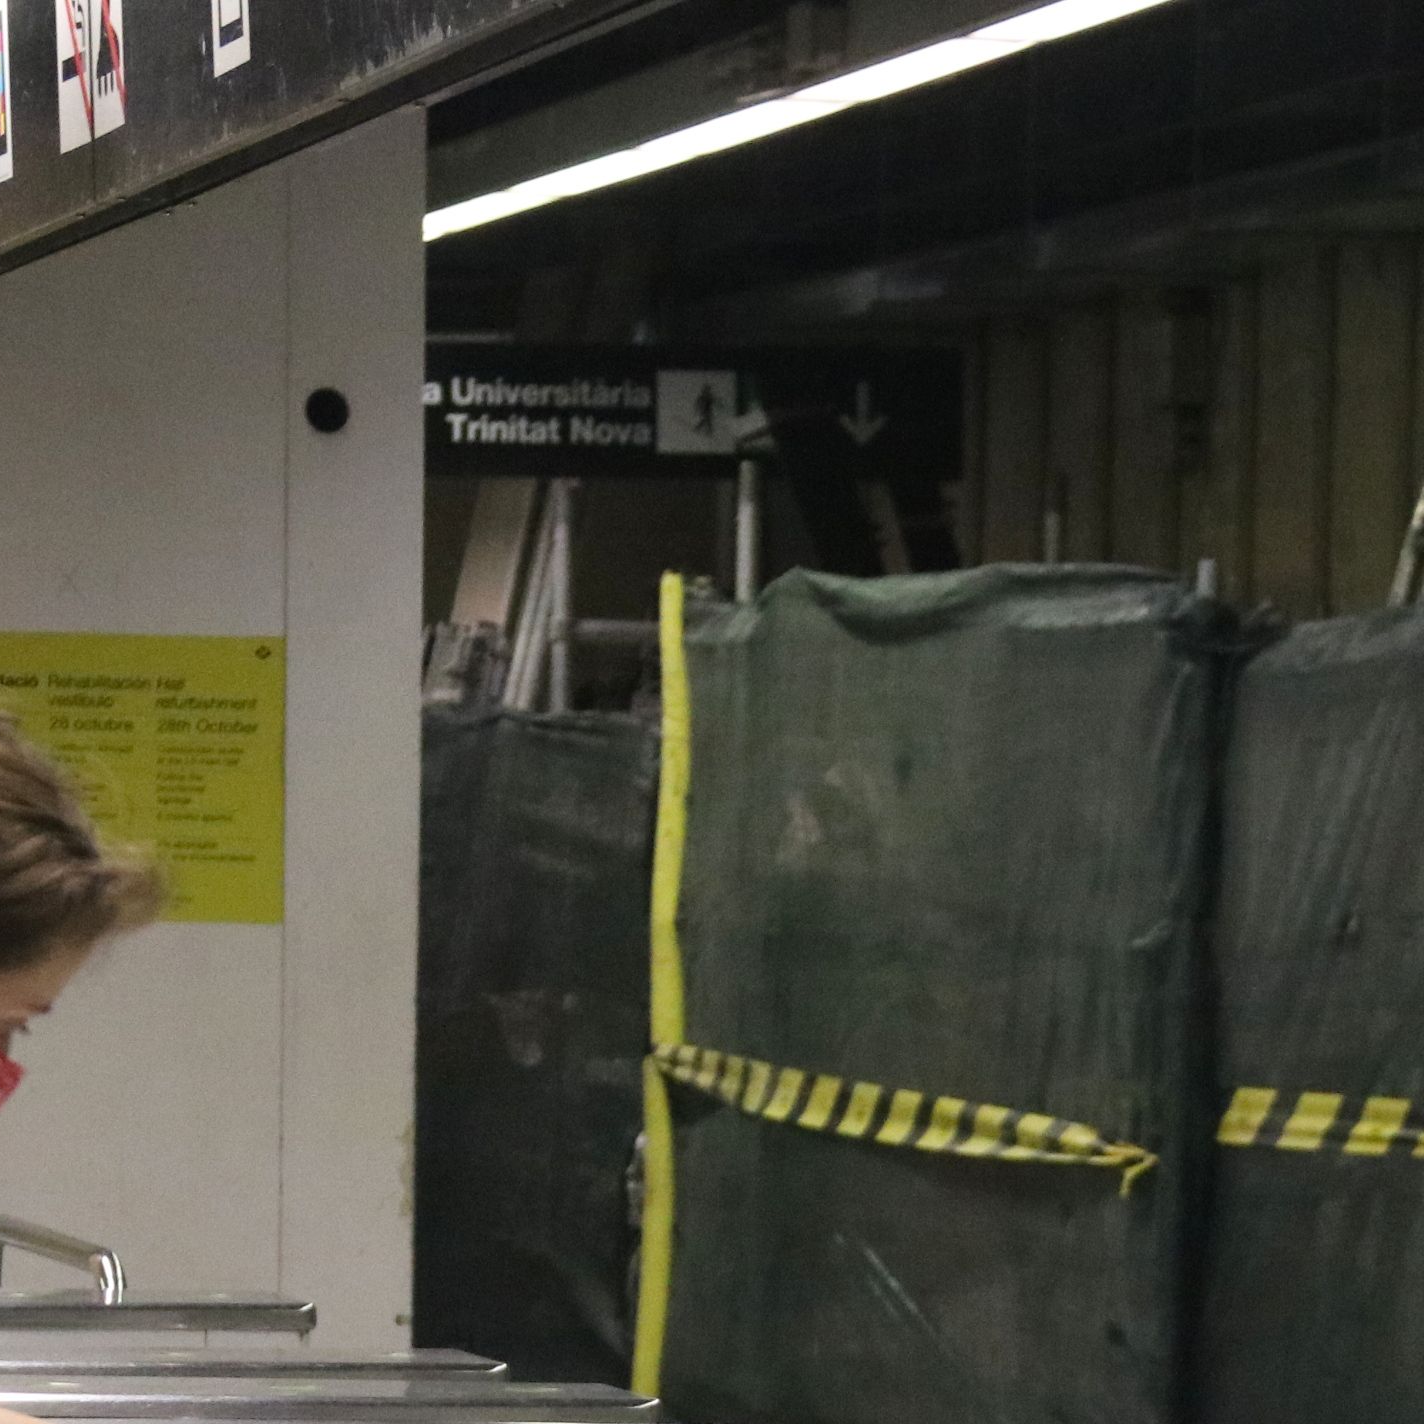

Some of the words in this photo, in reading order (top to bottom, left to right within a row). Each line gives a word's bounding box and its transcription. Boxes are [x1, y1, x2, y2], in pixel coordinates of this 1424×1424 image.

[451, 375, 651, 408] Universitària
[445, 412, 561, 444] Trinitat
[569, 414, 651, 445] Nova
[73, 714, 135, 733] octubre
[195, 717, 259, 734] October
